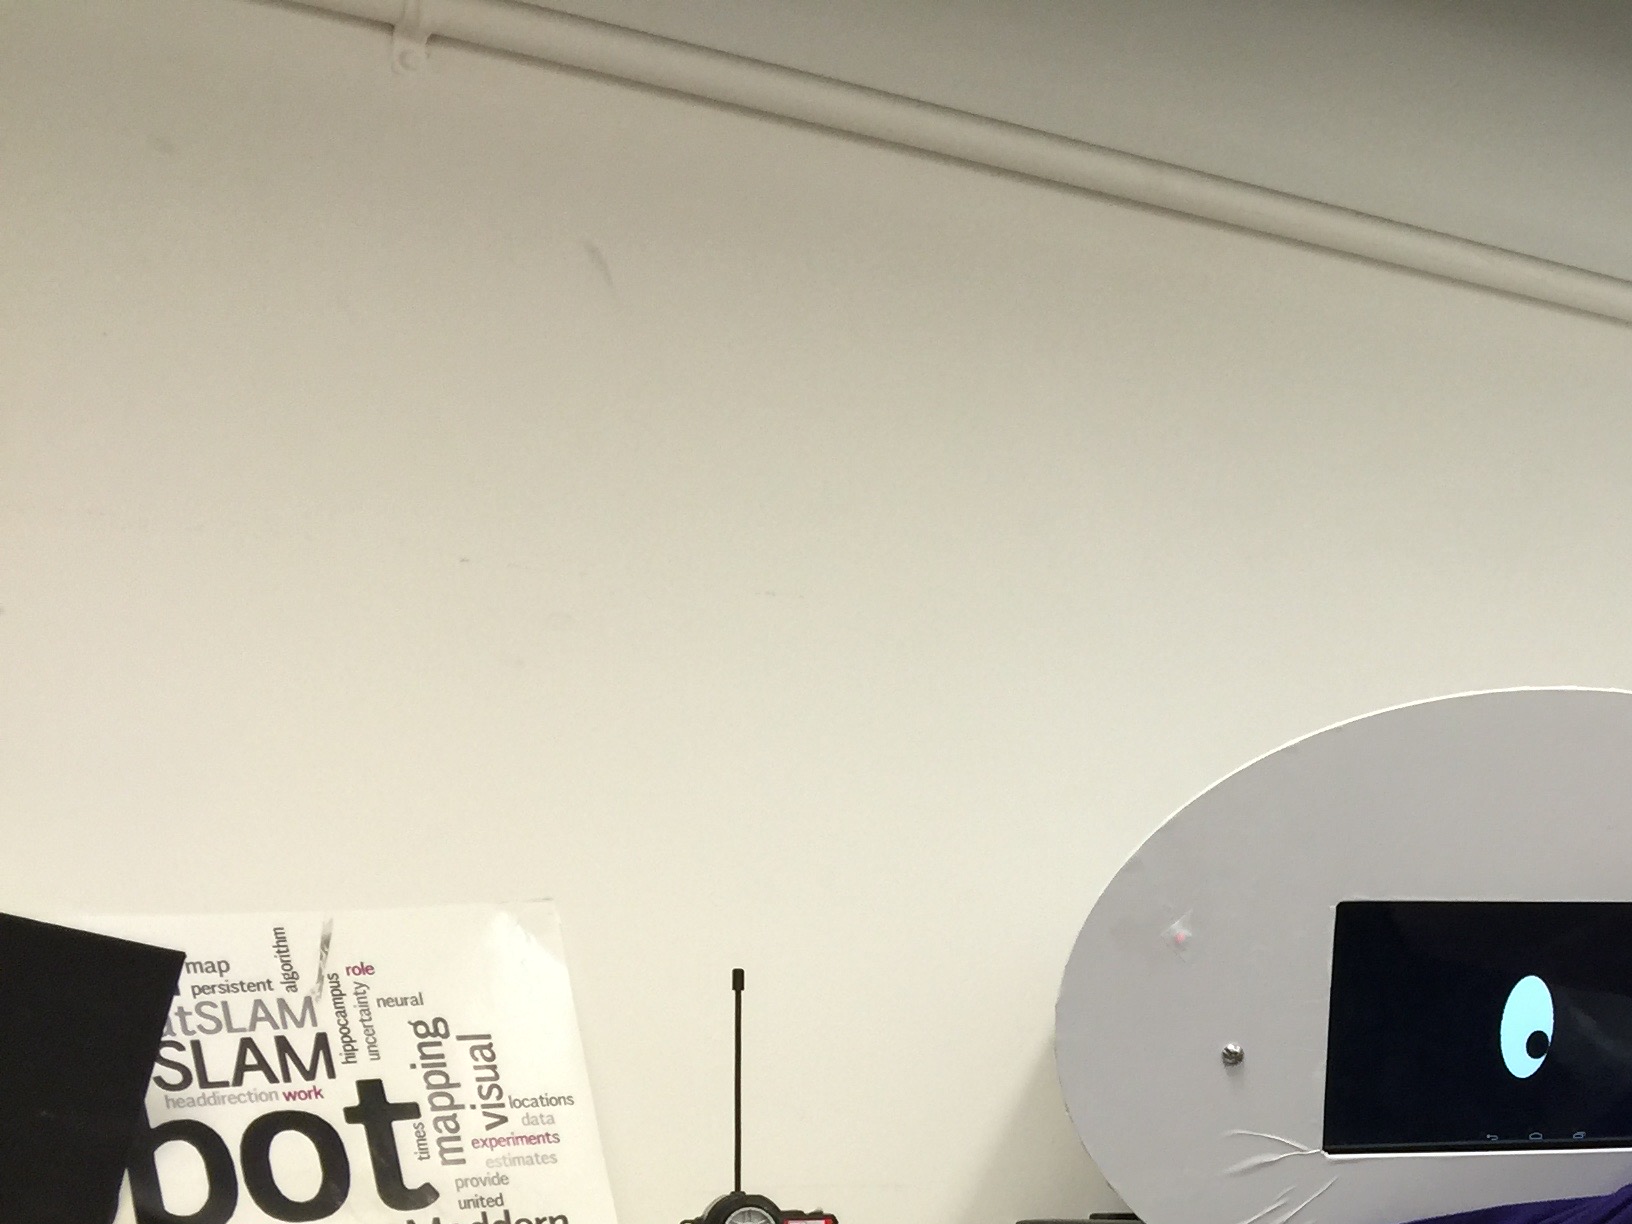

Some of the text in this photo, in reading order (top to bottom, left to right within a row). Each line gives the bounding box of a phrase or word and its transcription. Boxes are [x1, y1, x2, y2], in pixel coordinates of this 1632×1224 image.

[185, 959, 230, 977] map
[272, 926, 300, 993] algorithm
[345, 961, 375, 976] role
[191, 978, 274, 999] persistent
[376, 992, 424, 1008] neural
[327, 972, 358, 1065] hippocampus
[353, 981, 381, 1061] uncertainty
[153, 1031, 337, 1092] SLAM
[408, 1016, 467, 1166] mapping
[455, 1034, 509, 1131] visual
[164, 1087, 279, 1110] headdirection
[283, 1085, 325, 1102] work
[508, 1093, 575, 1109] locations
[521, 1112, 556, 1126] data
[413, 1121, 431, 1161] times
[471, 1131, 561, 1151] experiments
[485, 1152, 558, 1169] estimates
[455, 1172, 509, 1192] provide
[458, 1193, 504, 1210] united
